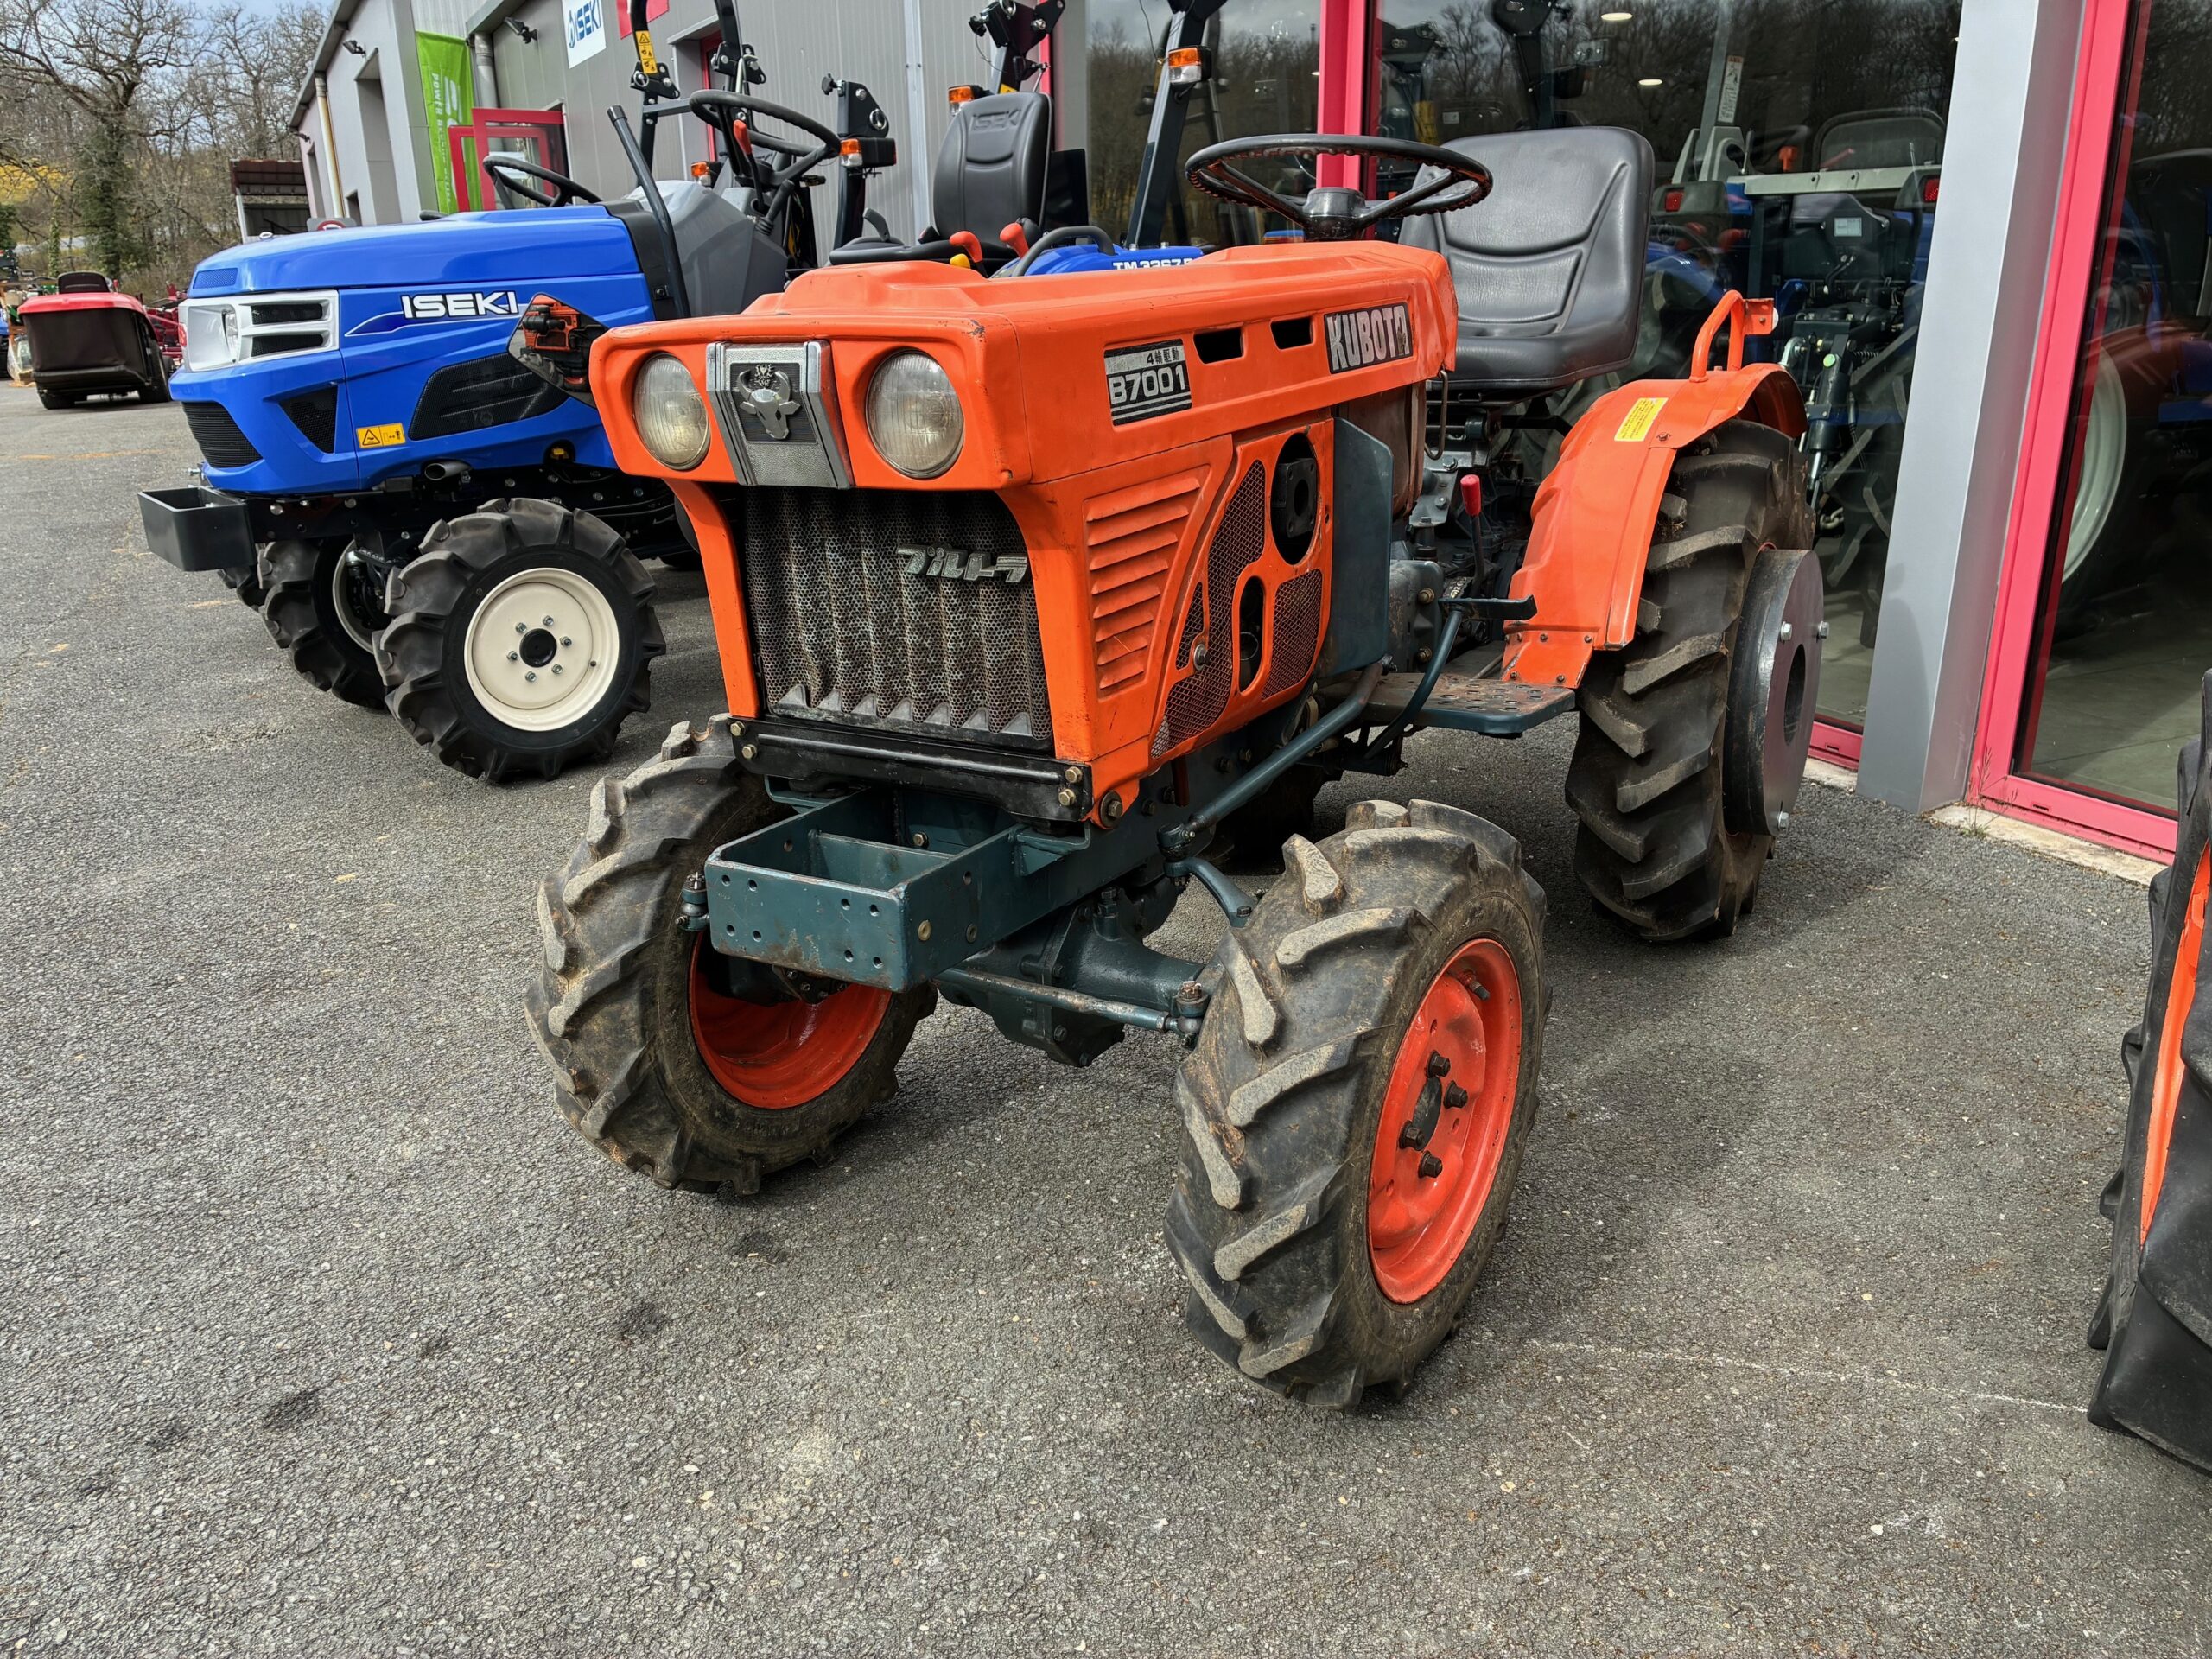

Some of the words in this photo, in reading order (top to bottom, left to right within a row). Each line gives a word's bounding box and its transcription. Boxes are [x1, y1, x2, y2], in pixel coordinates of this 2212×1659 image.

[401, 291, 518, 319] ISEKI
[1326, 305, 1410, 371] KUBOTA
[1108, 364, 1185, 404] B7001
